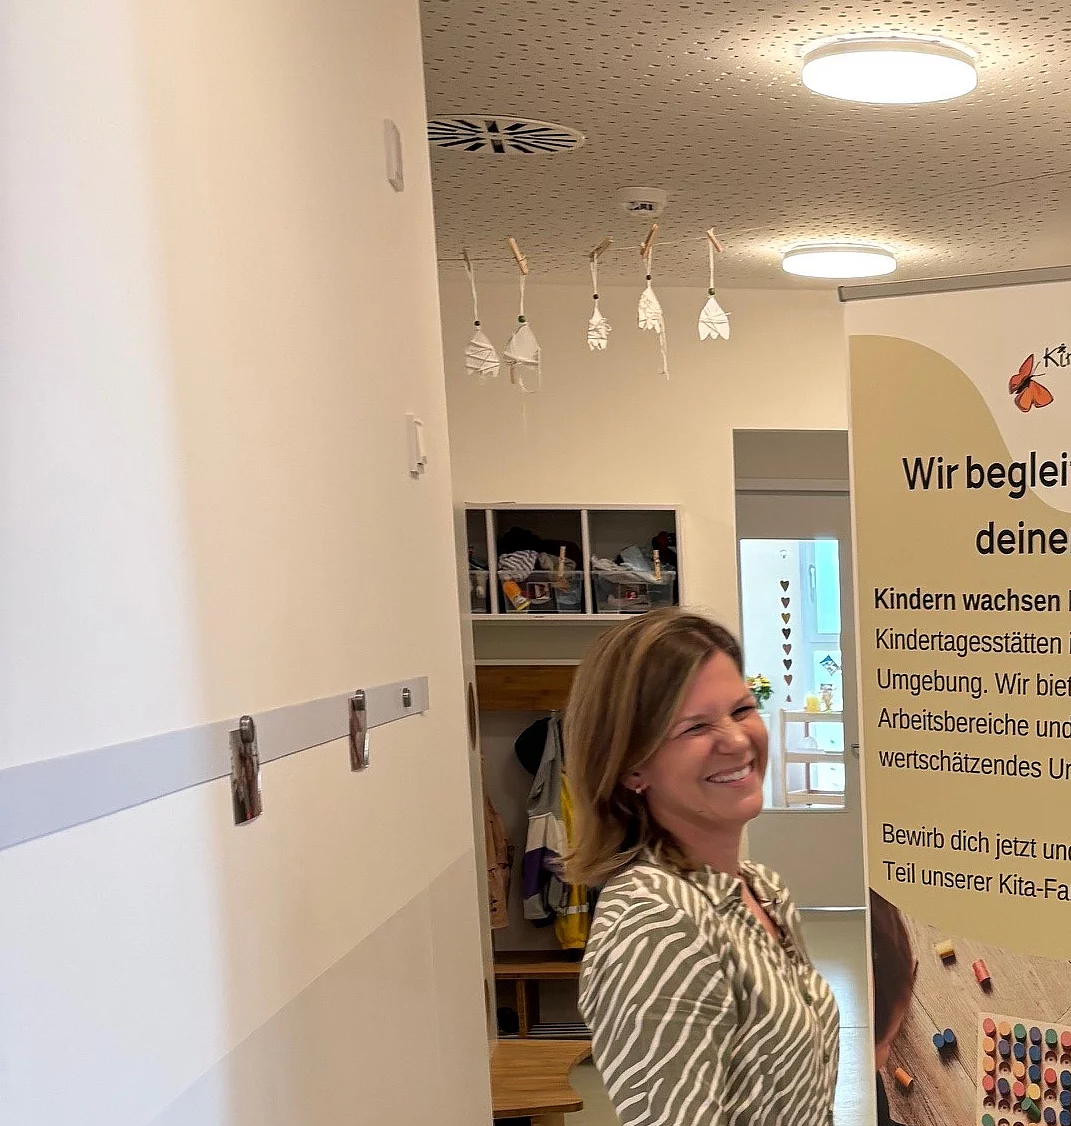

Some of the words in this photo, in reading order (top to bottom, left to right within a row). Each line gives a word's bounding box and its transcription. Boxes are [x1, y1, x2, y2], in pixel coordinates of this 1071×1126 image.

[901, 456, 960, 491] Wir
[874, 586, 957, 611] Kindern
[962, 587, 1061, 612] wachsen
[875, 627, 1062, 658] Kindertagesstätten
[876, 667, 988, 700] Umgebung.
[994, 672, 1031, 696] Wir
[877, 707, 1030, 737] Arbeitsbereiche
[878, 749, 1042, 779] wertschätzendes
[882, 823, 945, 849] Bewirb
[950, 829, 990, 854] dich
[994, 832, 1038, 861] jetzt
[882, 860, 916, 884] Teil
[921, 869, 994, 893] unserer
